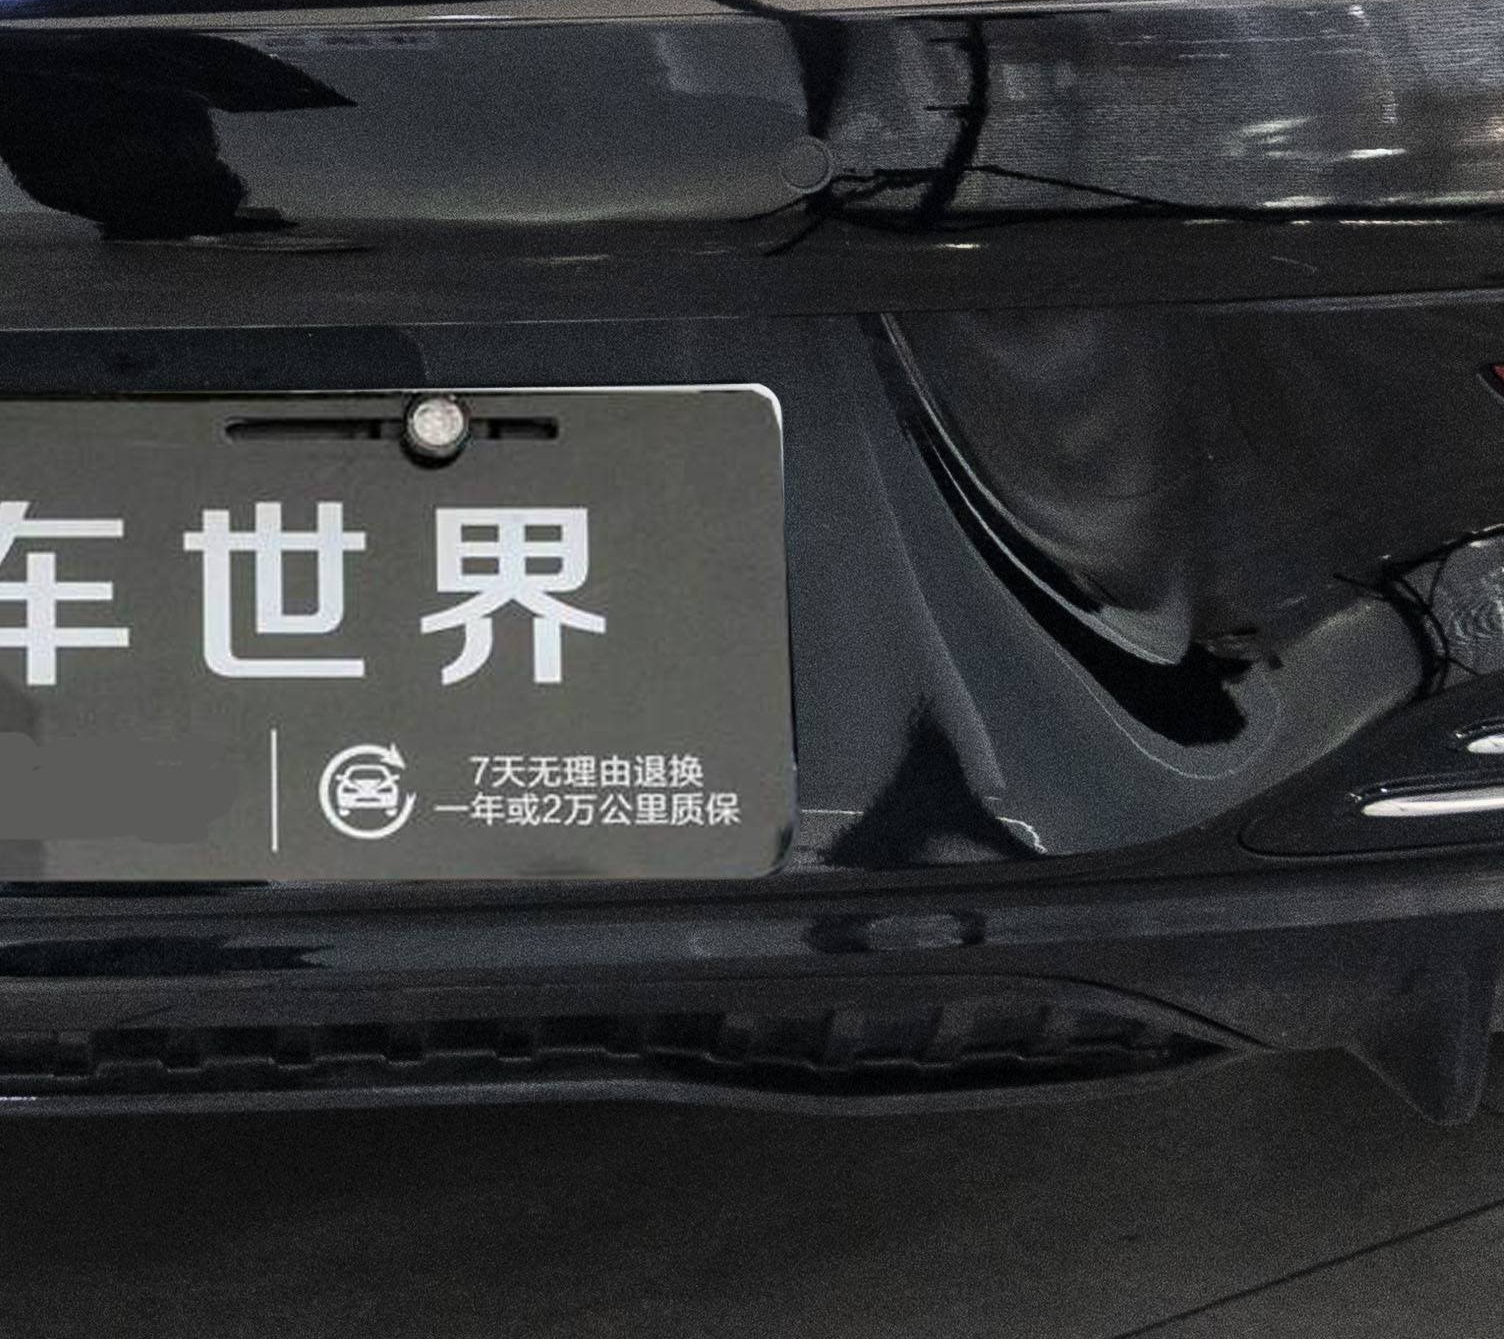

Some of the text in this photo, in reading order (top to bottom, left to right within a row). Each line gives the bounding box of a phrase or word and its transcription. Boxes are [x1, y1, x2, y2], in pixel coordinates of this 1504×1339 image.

[469, 755, 704, 789] 7天无理由退换
[433, 793, 741, 828] 一年或2万公里质保
